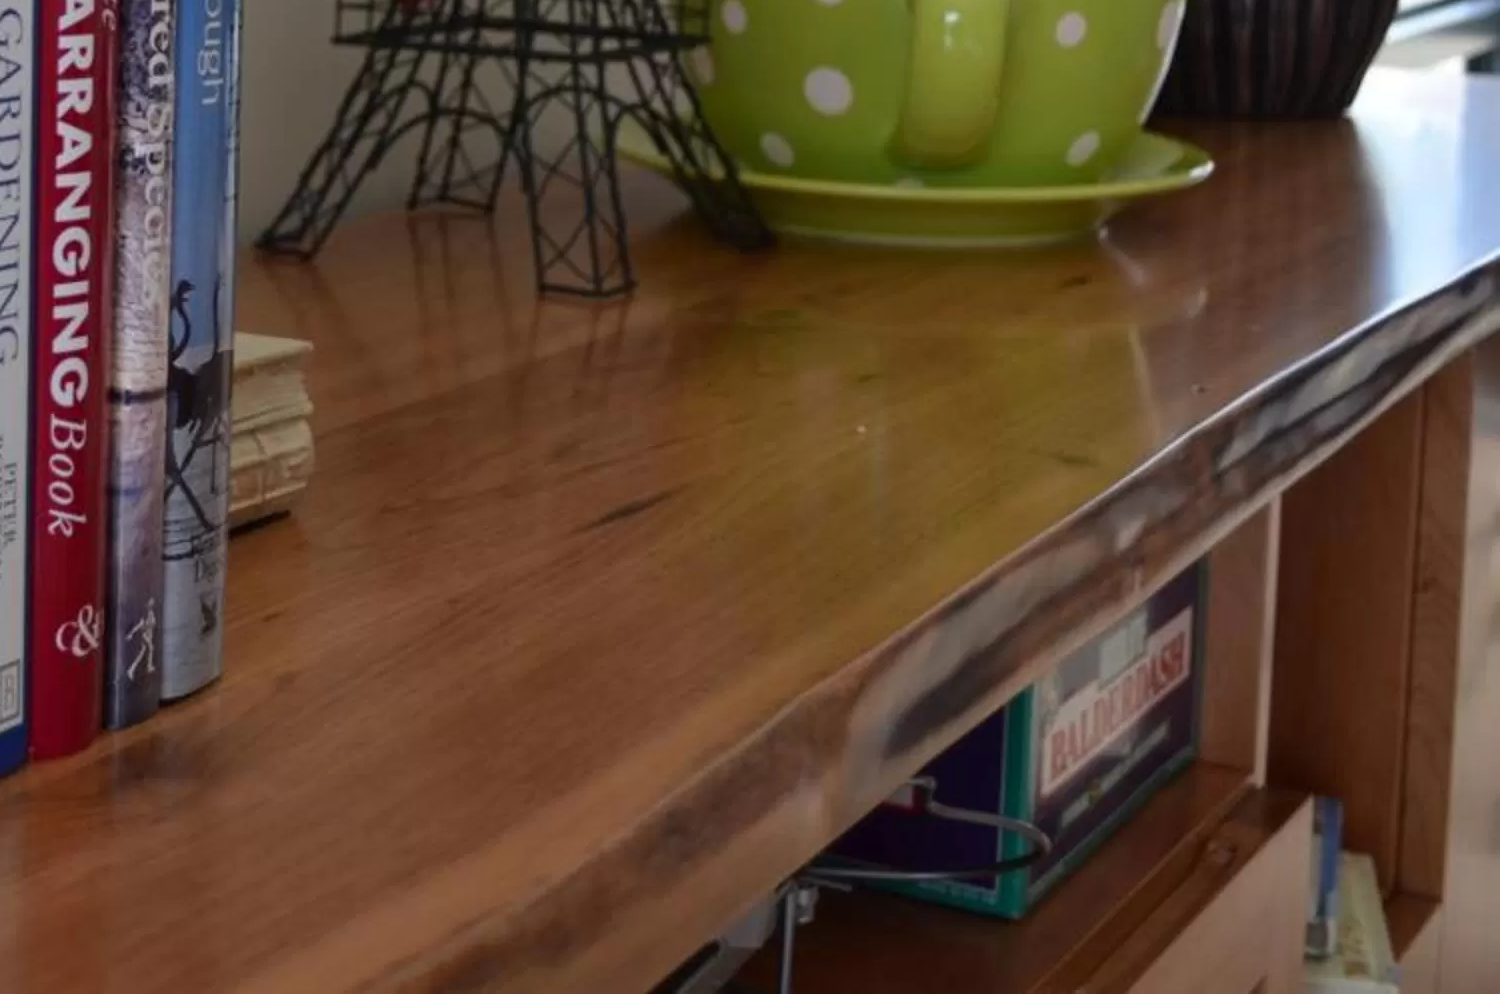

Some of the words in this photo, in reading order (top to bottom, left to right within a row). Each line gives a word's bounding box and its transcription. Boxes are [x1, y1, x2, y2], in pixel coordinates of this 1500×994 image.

[133, 104, 171, 308] Species
[3, 461, 18, 546] PETER
[48, 413, 87, 539] Book
[1050, 630, 1186, 783] BALDERDASH
